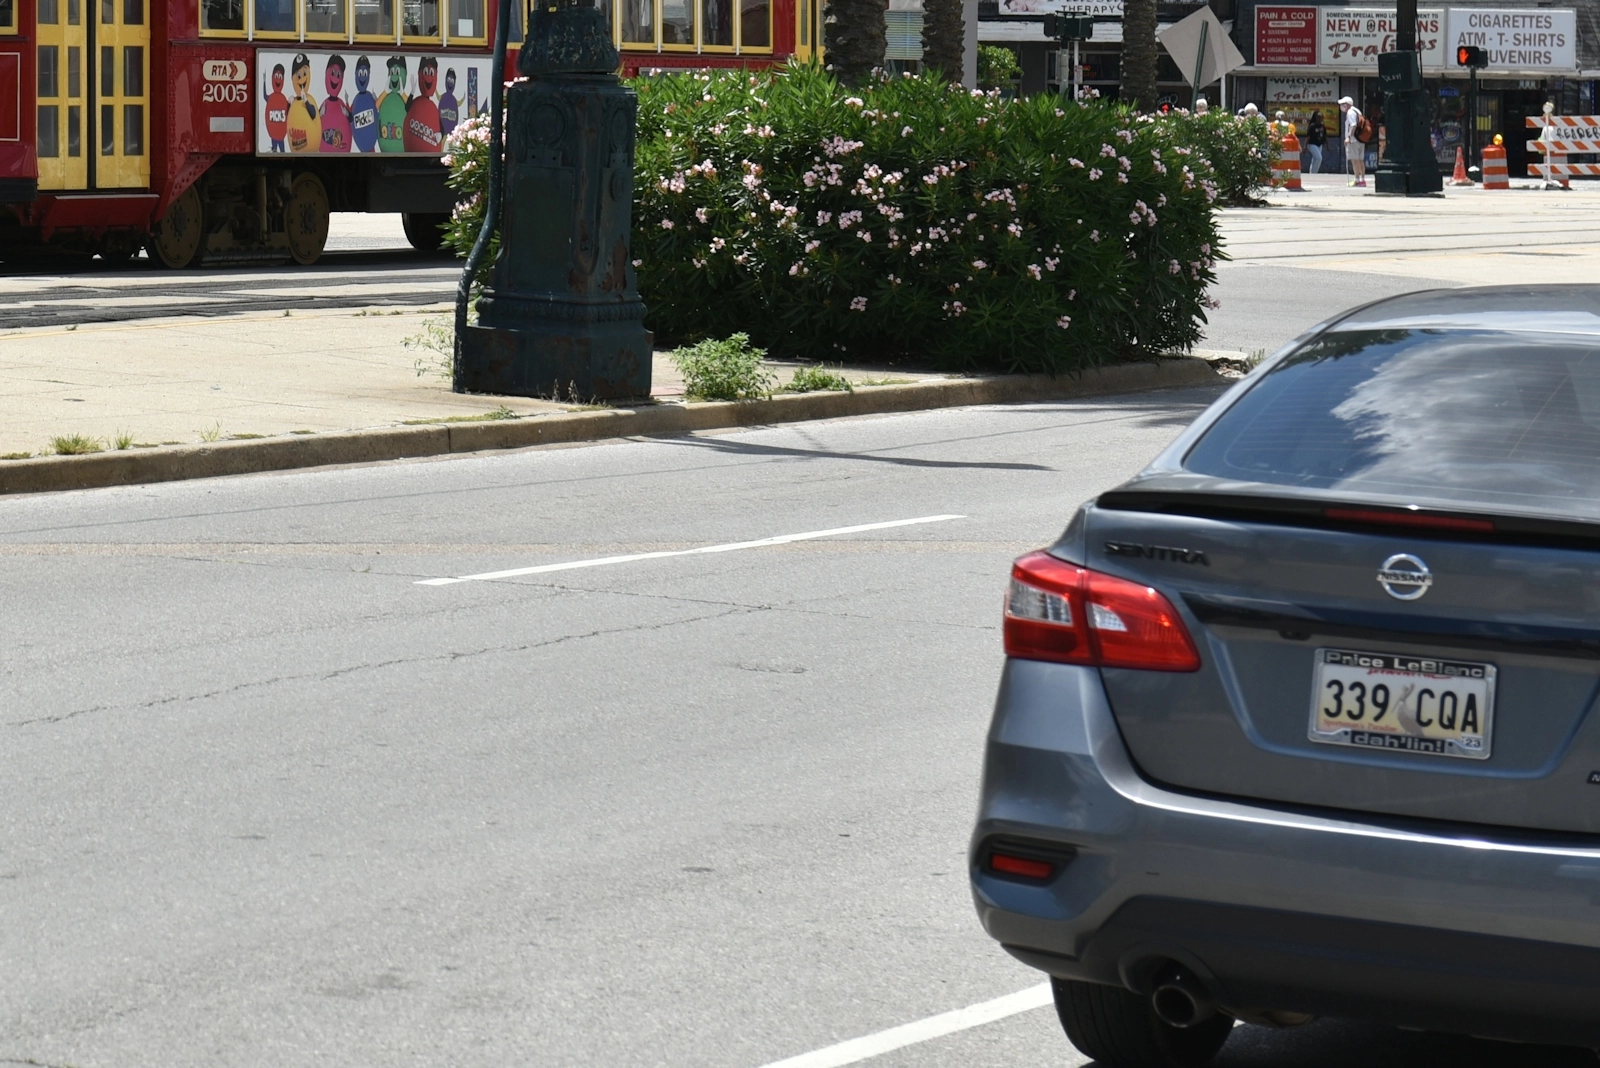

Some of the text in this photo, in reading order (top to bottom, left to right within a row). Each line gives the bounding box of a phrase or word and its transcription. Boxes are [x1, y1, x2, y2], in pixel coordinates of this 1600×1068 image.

[1061, 5, 1115, 14] THERAPY
[1260, 12, 1314, 20] PAIN & COLD
[1326, 19, 1439, 33] NEW ORLNS
[1468, 13, 1552, 29] CIGARETTES
[1328, 34, 1437, 59] Pralies
[1458, 32, 1486, 46] ATM
[1512, 32, 1565, 47] SHIRTS
[1488, 50, 1552, 65] UVENIRS
[211, 65, 228, 76] RTA
[202, 83, 248, 103] 2005
[1274, 88, 1332, 100] Pralines
[1103, 540, 1211, 567] SENTRA
[1380, 571, 1429, 583] NISSAN
[1326, 652, 1384, 668] Price
[1393, 658, 1484, 678] LeBlanc
[1323, 679, 1478, 734] 339 CQA
[1323, 720, 1398, 732] Sportsman's Paradise
[1354, 732, 1442, 753] dah'lin!
[1465, 738, 1481, 748] 23
